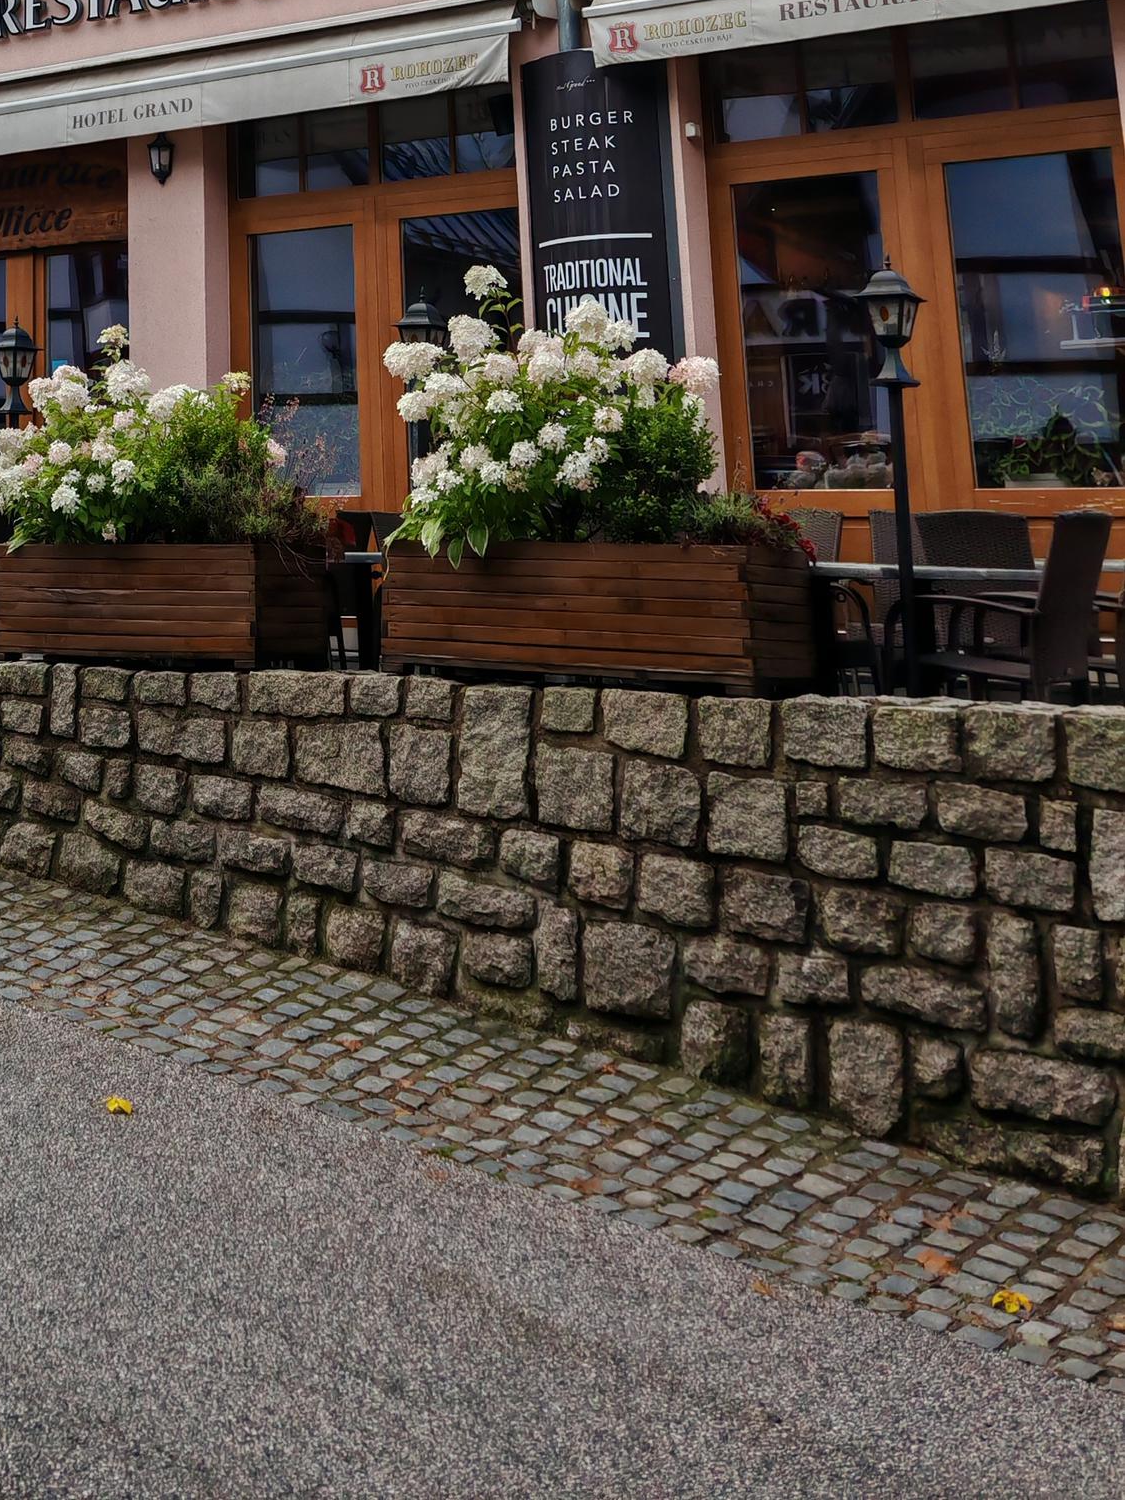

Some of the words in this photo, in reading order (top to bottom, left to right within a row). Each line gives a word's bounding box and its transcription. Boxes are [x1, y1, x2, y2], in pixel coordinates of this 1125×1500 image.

[644, 11, 748, 41] ROHOZEC
[72, 108, 128, 129] HOTEL
[133, 98, 193, 120] GRAND
[550, 111, 633, 131] BURGER
[551, 135, 616, 155] STEAK
[553, 160, 615, 179] PASTA
[554, 184, 620, 203] SALAD
[544, 258, 648, 293] TRADITIONAL
